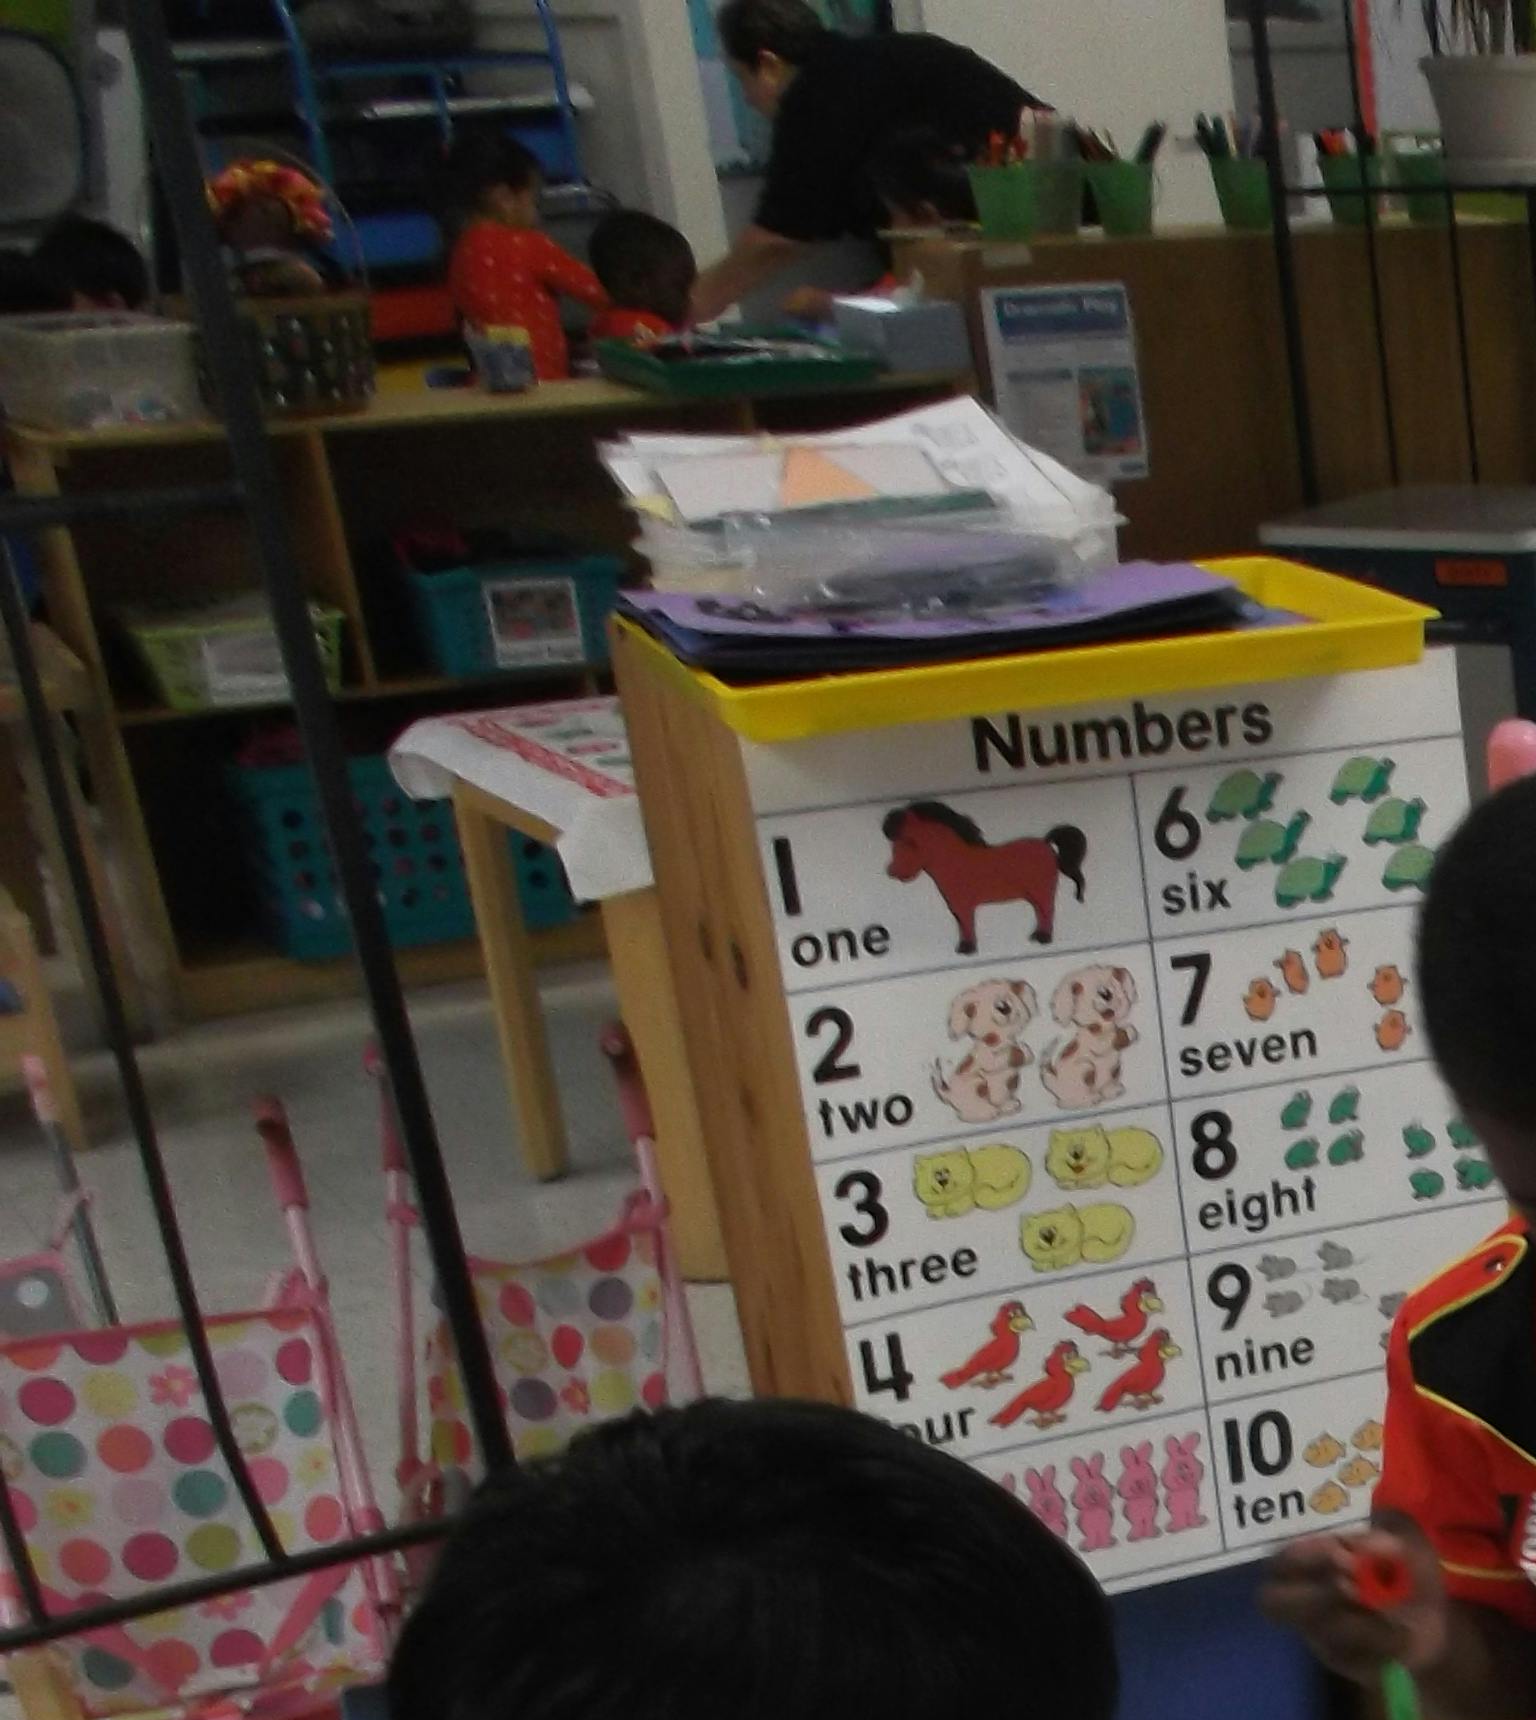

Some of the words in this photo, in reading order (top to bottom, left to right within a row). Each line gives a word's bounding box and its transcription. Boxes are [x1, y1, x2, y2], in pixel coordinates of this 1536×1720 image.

[971, 700, 1274, 773] Numbers
[1154, 786, 1202, 860] 6
[772, 836, 800, 915] 1
[1161, 870, 1233, 916] six
[791, 921, 891, 968] one
[1170, 953, 1212, 1026] 7
[805, 1007, 861, 1085] 2
[1179, 1022, 1318, 1078] seven
[817, 1091, 914, 1138] two
[1190, 1110, 1238, 1180] 8
[834, 1170, 889, 1248] 3
[1198, 1178, 1318, 1234] eight
[847, 1244, 978, 1302] three
[1208, 1261, 1252, 1331] 9
[861, 1330, 914, 1402] 4
[1215, 1337, 1317, 1382] nine
[1223, 1408, 1292, 1485] 10
[1233, 1489, 1306, 1529] ten
